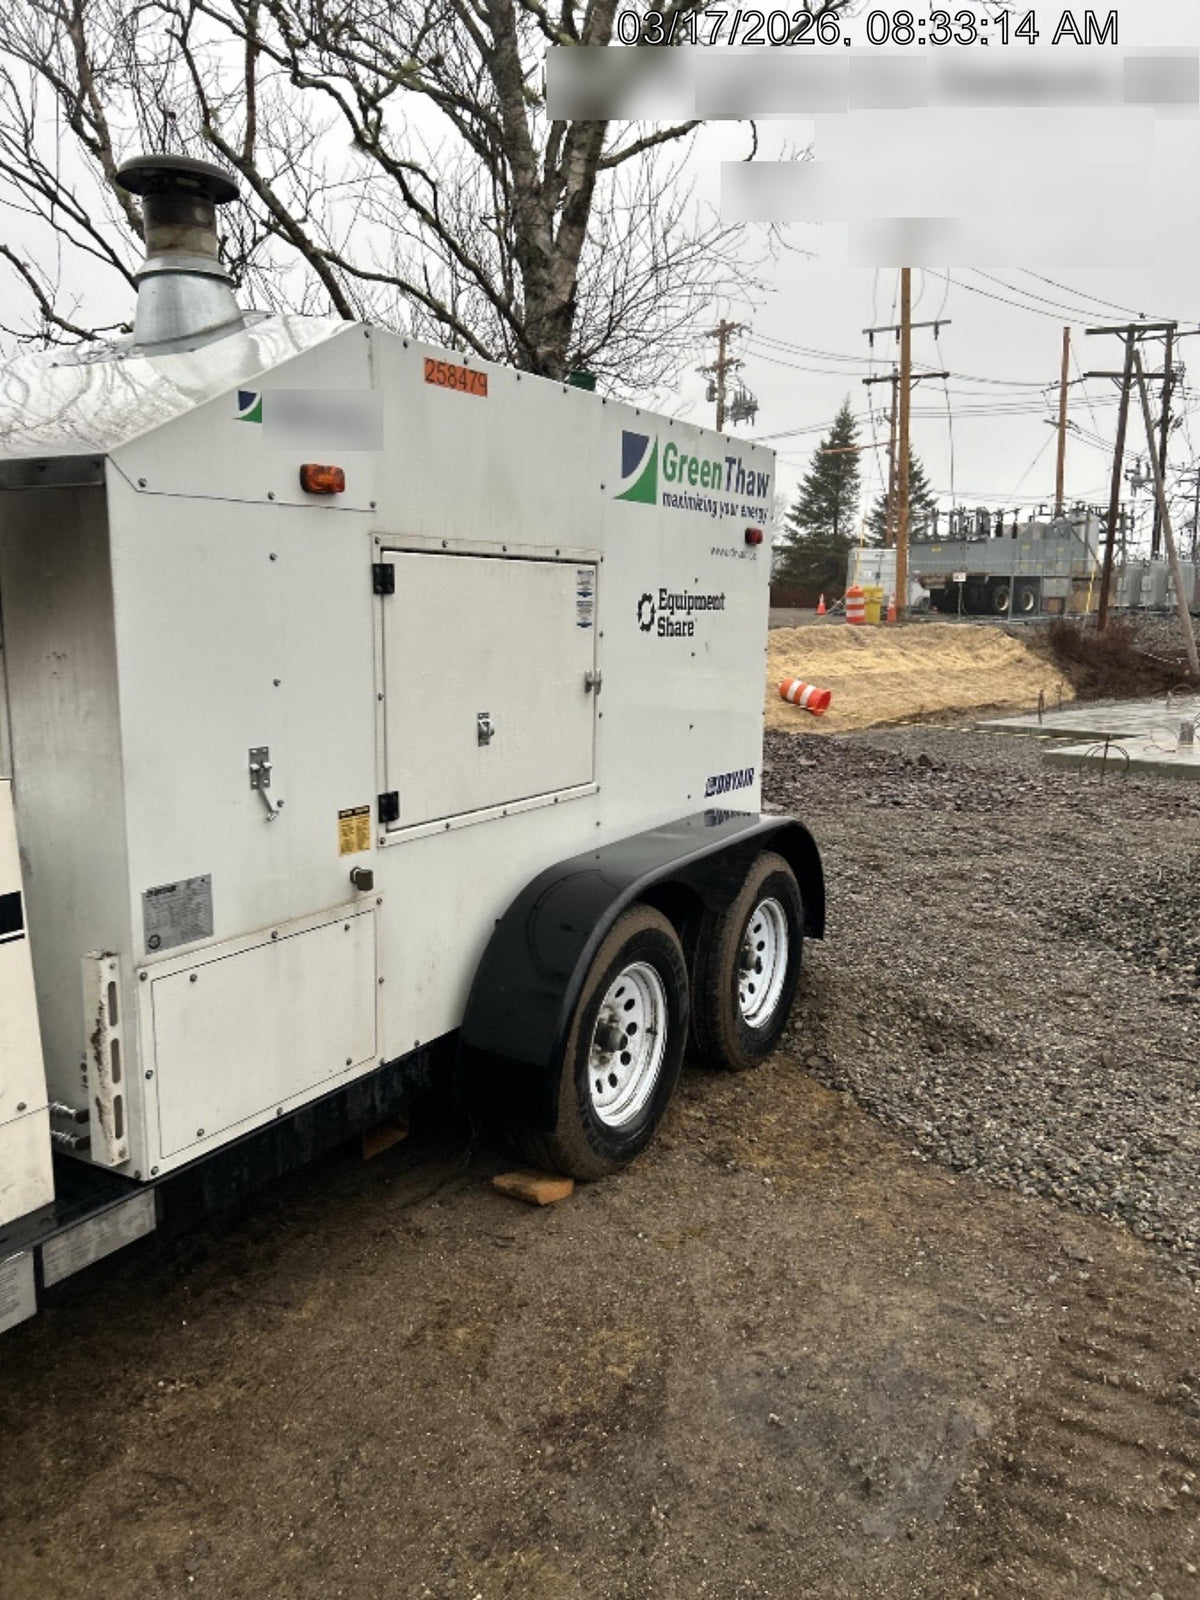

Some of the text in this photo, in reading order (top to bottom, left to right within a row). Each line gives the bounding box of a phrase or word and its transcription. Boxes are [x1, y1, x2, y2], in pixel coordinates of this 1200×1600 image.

[425, 357, 488, 396] 258479
[663, 491, 769, 525] maximizing your energy
[658, 588, 725, 615] Equipment
[658, 616, 695, 637] Share
